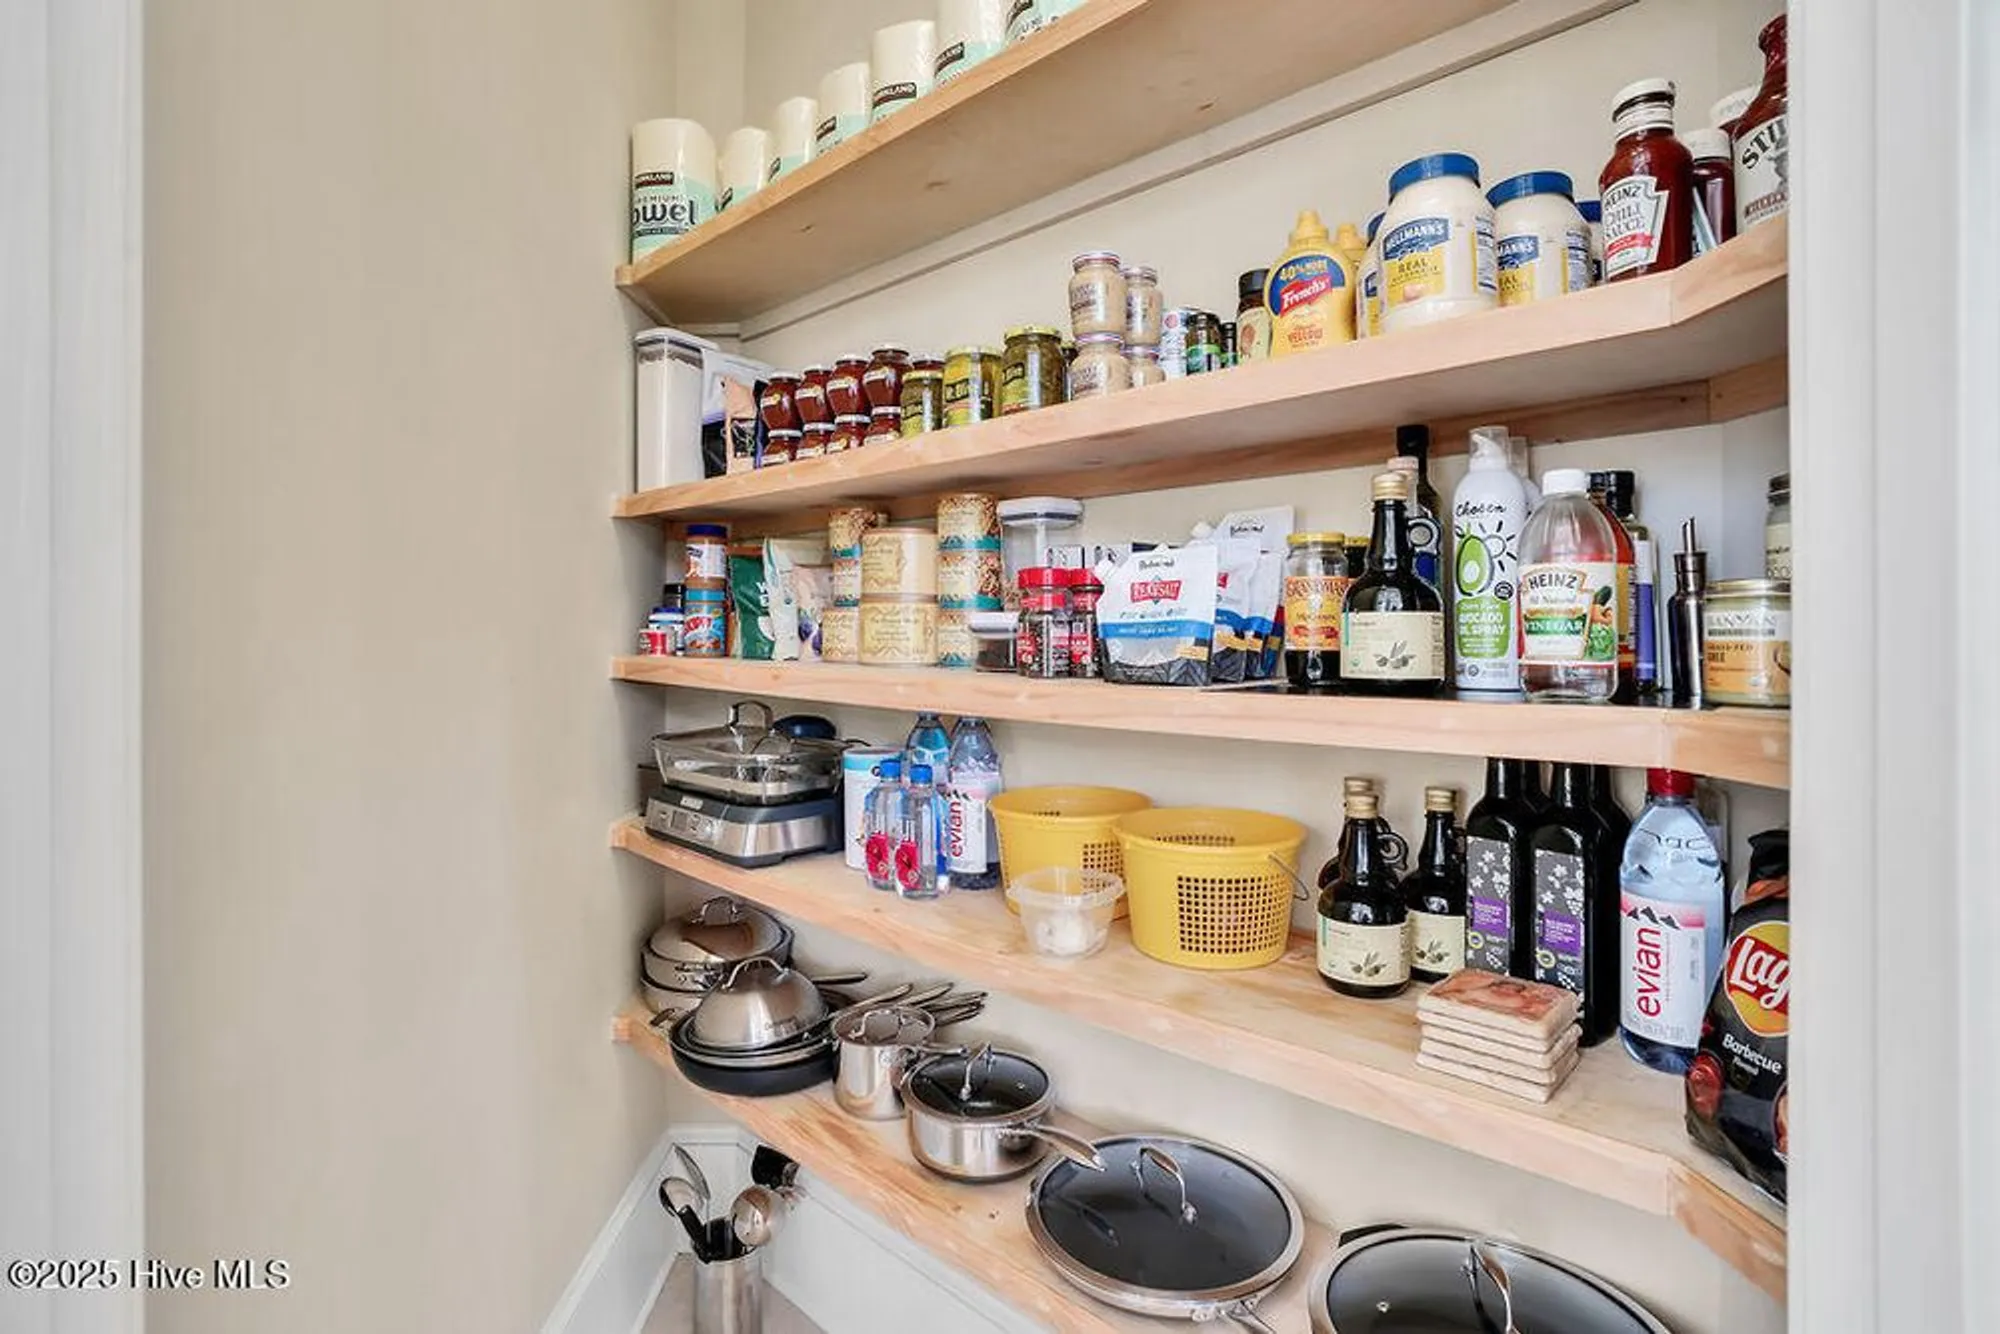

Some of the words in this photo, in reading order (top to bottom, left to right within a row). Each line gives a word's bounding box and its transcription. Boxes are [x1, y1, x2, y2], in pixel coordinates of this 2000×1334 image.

[631, 200, 696, 225] owel
[1282, 279, 1330, 309] French's
[1528, 573, 1577, 589] HEINZ
[1632, 927, 1661, 1018] evian
[1730, 938, 1789, 1009] Lay
[1722, 1033, 1782, 1075] Barbecue
